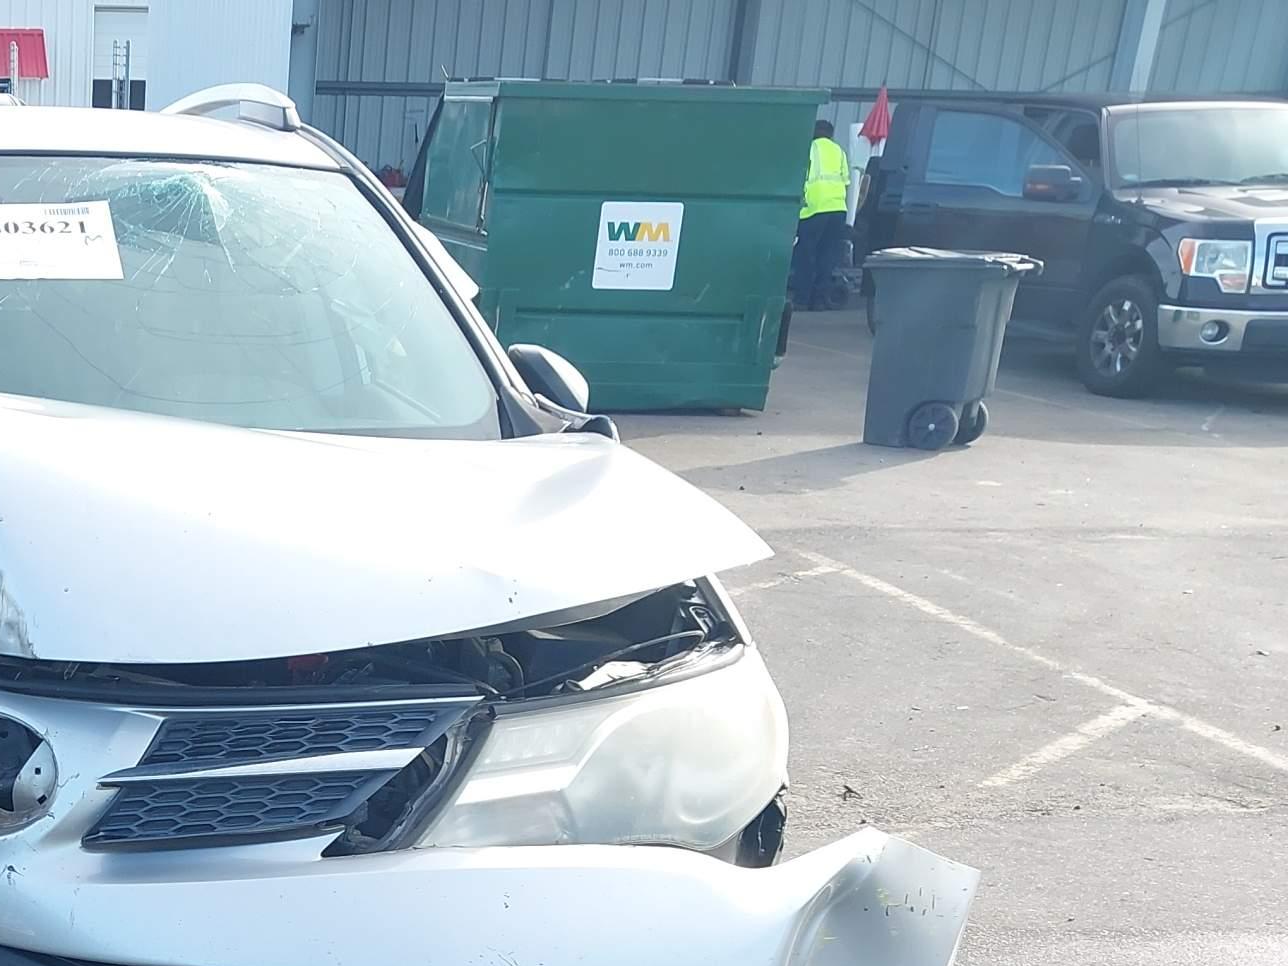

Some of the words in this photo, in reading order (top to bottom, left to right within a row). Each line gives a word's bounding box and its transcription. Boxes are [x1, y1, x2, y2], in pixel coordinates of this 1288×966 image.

[607, 222, 671, 241] WM
[608, 248, 625, 257] 800
[627, 248, 644, 257] 688
[646, 248, 668, 257] 9339
